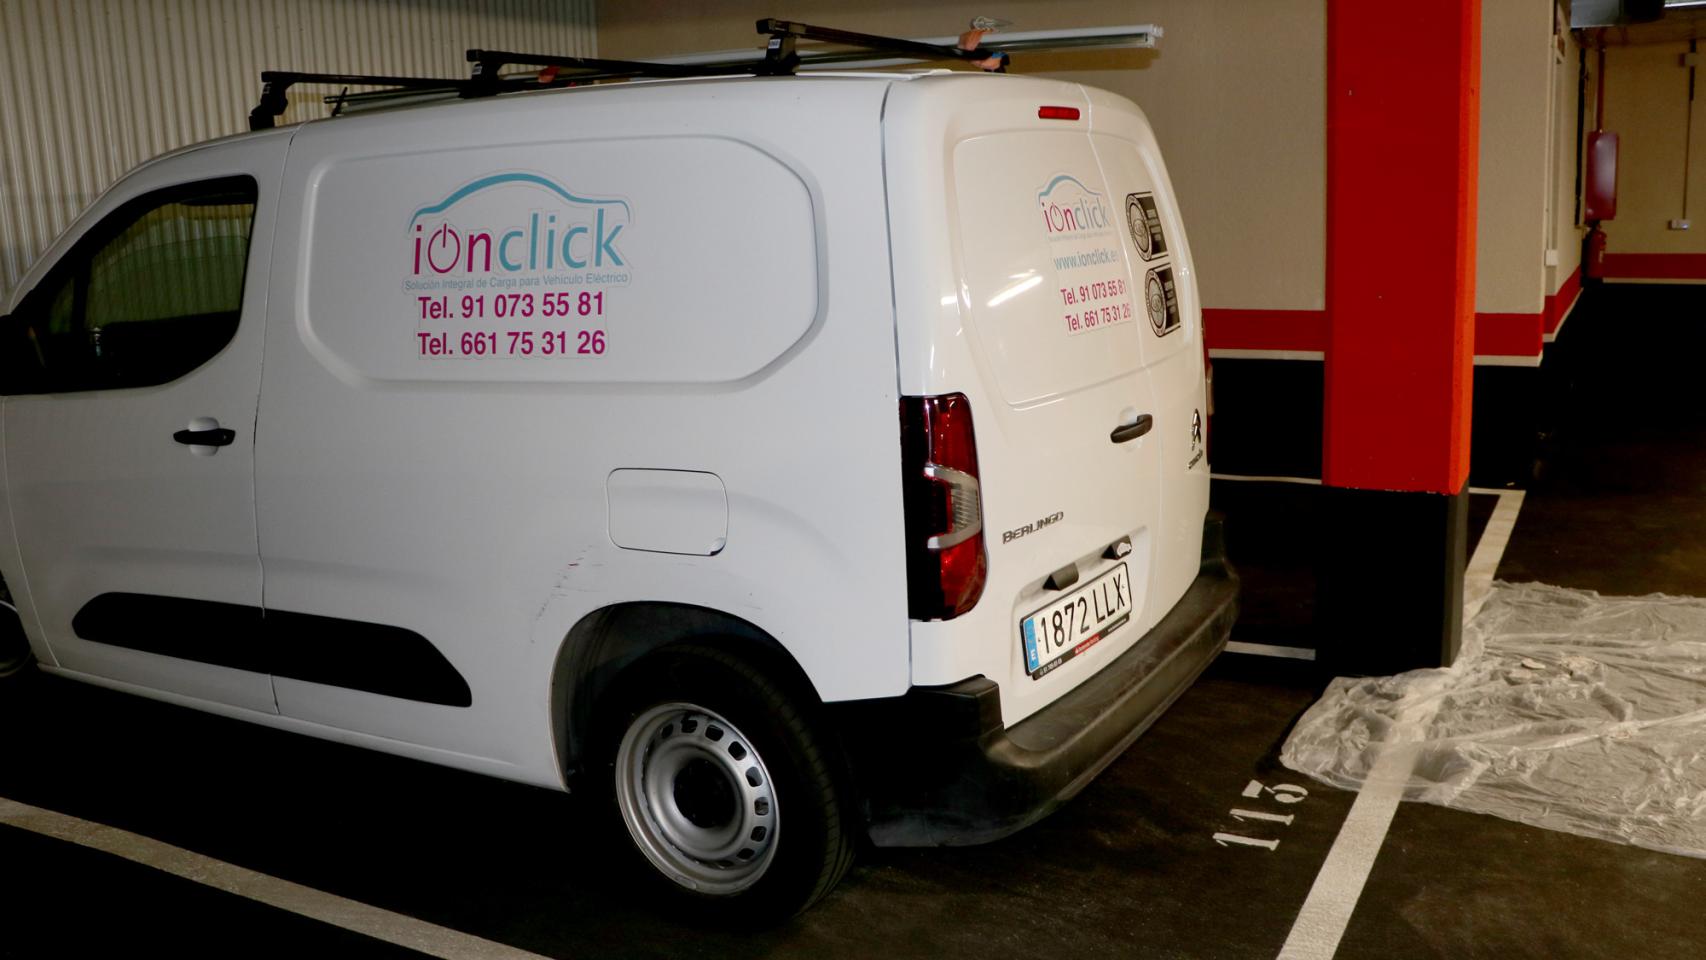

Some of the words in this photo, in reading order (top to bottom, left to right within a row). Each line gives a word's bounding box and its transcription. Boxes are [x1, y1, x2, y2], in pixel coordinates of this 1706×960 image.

[1041, 197, 1111, 233] ionclick
[413, 207, 625, 275] ionclick
[404, 279, 440, 290] Solución
[441, 278, 474, 291] Integral
[476, 277, 488, 289] de
[489, 276, 518, 291] Carga
[519, 277, 541, 290] para
[542, 272, 583, 286] Vehículo
[585, 271, 628, 284] Eléctrico
[1060, 287, 1079, 306] Tel.
[1079, 285, 1091, 303] 91
[1091, 281, 1107, 300] 073
[1107, 280, 1118, 297] 55
[417, 295, 454, 319] Tel.
[461, 294, 484, 319] 91
[493, 293, 535, 318] 073
[541, 292, 570, 317] 55
[577, 291, 603, 316] 81
[1065, 313, 1083, 332] Tel.
[1084, 310, 1100, 328] 661
[1100, 307, 1112, 323] 75
[1112, 304, 1121, 321] 31
[417, 331, 454, 356] Tel.
[460, 331, 497, 355] 661
[506, 331, 534, 355] 75
[541, 330, 566, 355] 31
[576, 329, 606, 355] 26
[1040, 596, 1090, 654] 1872
[1092, 573, 1126, 624] LLX
[1212, 779, 1309, 852] 113
